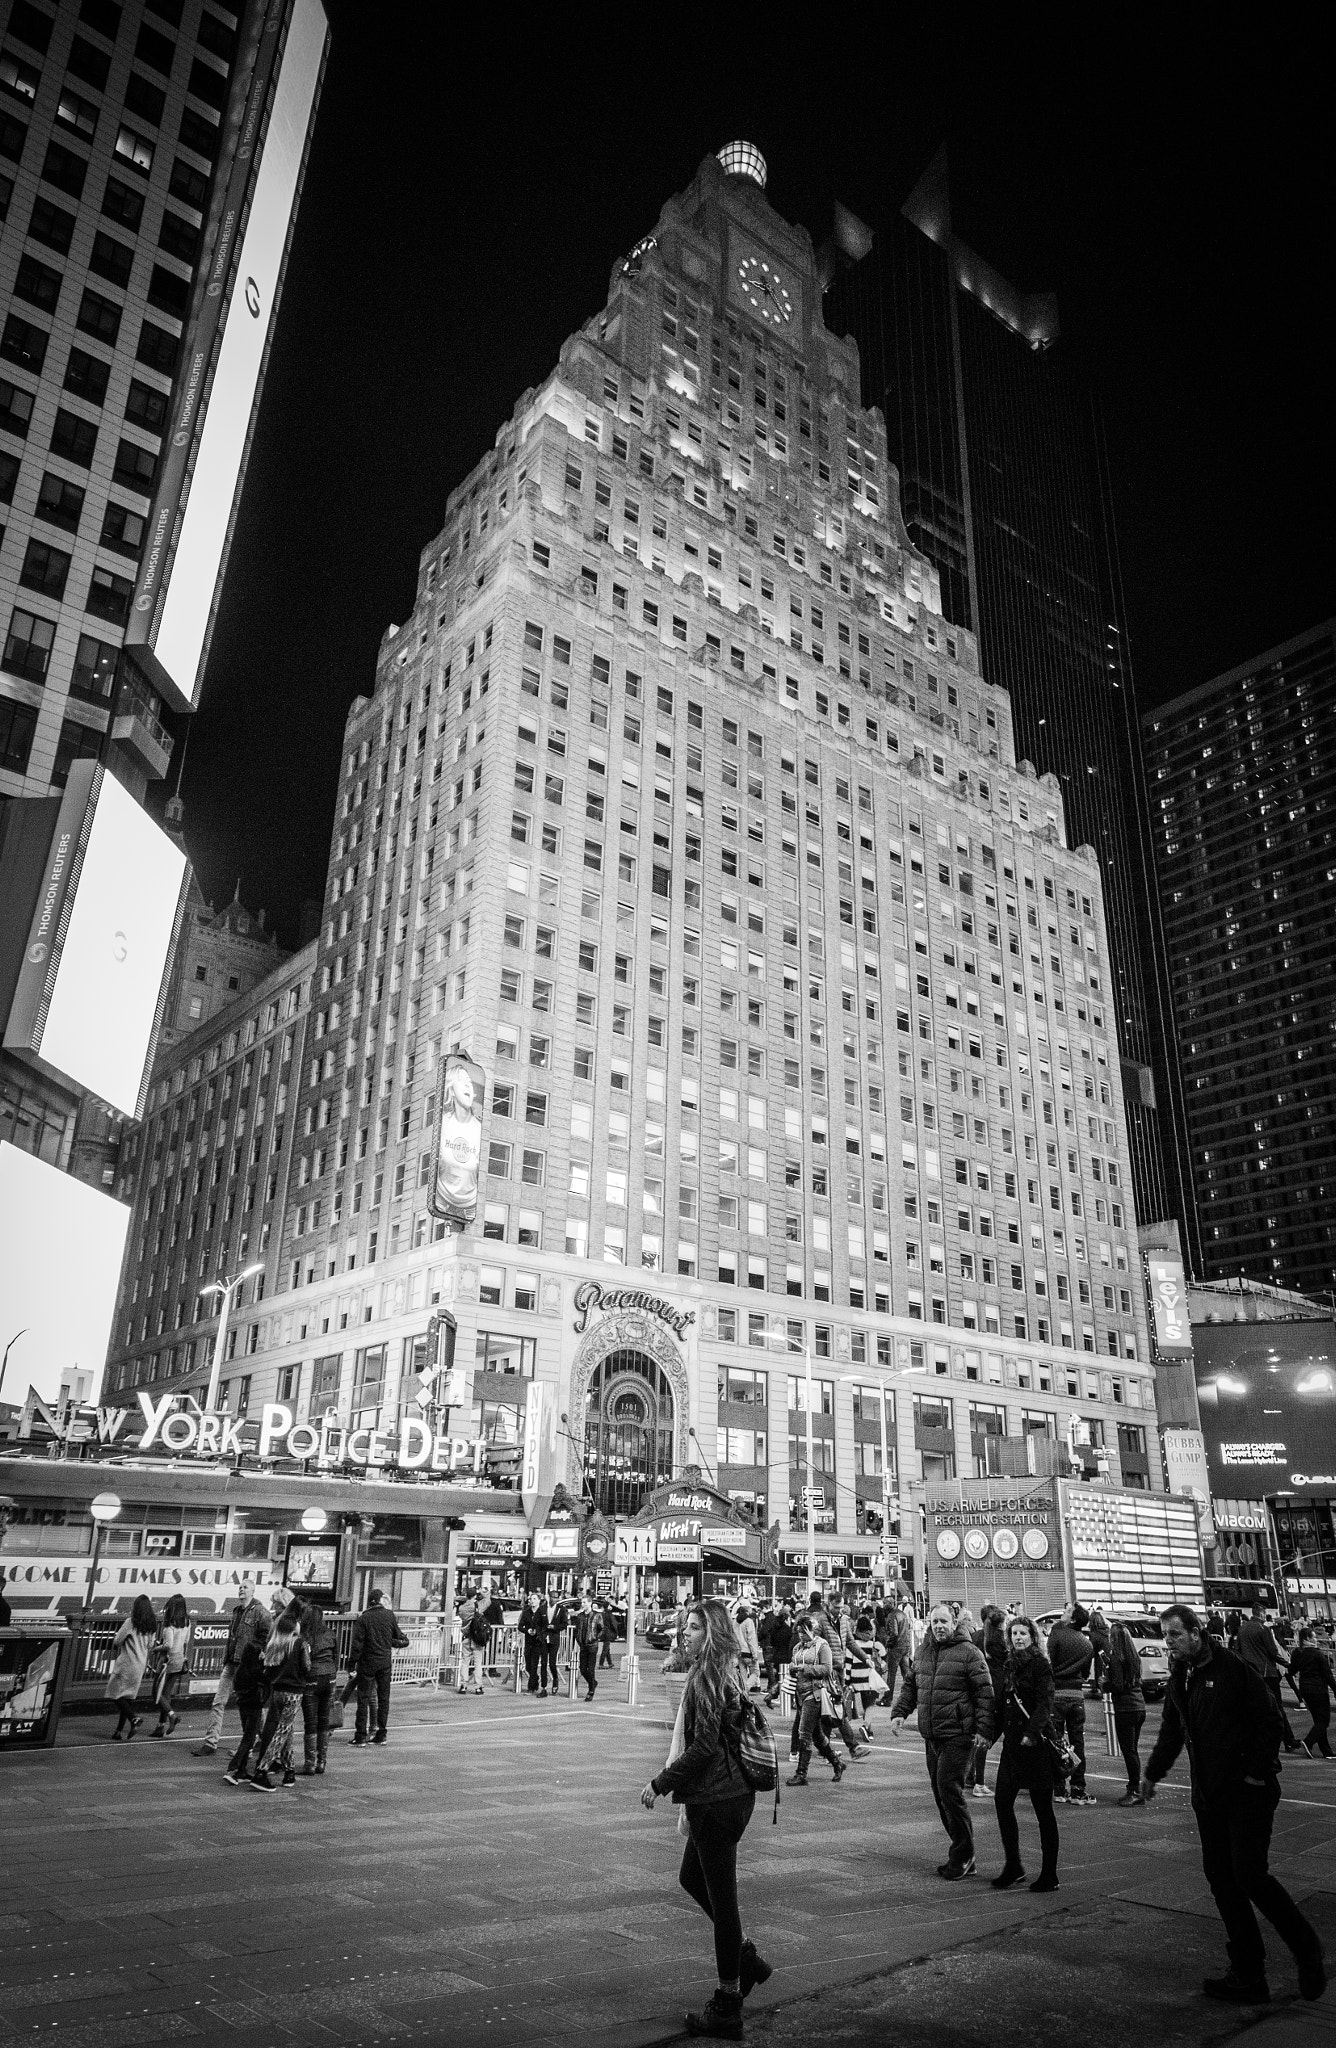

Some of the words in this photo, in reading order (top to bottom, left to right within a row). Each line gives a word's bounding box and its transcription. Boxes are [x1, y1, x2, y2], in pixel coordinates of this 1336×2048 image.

[213, 243, 228, 279] THOMSON
[221, 210, 235, 242] REUTERS
[180, 388, 196, 428] THOMSON
[189, 353, 204, 387] REUTERS
[143, 547, 160, 590] THOMSON
[153, 508, 170, 546] REUTERS
[37, 883, 59, 937] THOMSON
[51, 833, 71, 880] REUTERS
[445, 1139, 461, 1151] Hard
[574, 1281, 696, 1341] Paramount
[621, 1402, 637, 1411] 1501
[17, 1384, 128, 1443] NEW
[136, 1391, 246, 1454] YORK
[259, 1404, 388, 1465] POLICE
[398, 1417, 488, 1472] DEPT
[527, 1386, 541, 1490] NYPD
[1166, 1435, 1203, 1449] BUBBA
[1170, 1450, 1202, 1464] GUMP
[668, 1493, 691, 1507] Hard
[691, 1495, 713, 1511] Rock
[951, 1499, 998, 1512] ARMED
[1000, 1498, 1055, 1512] FORCES
[934, 1513, 998, 1526] RECRUITING
[1000, 1513, 1048, 1525] STATION
[117, 1567, 182, 1585] TIMES
[194, 1626, 230, 1640] Subwa
